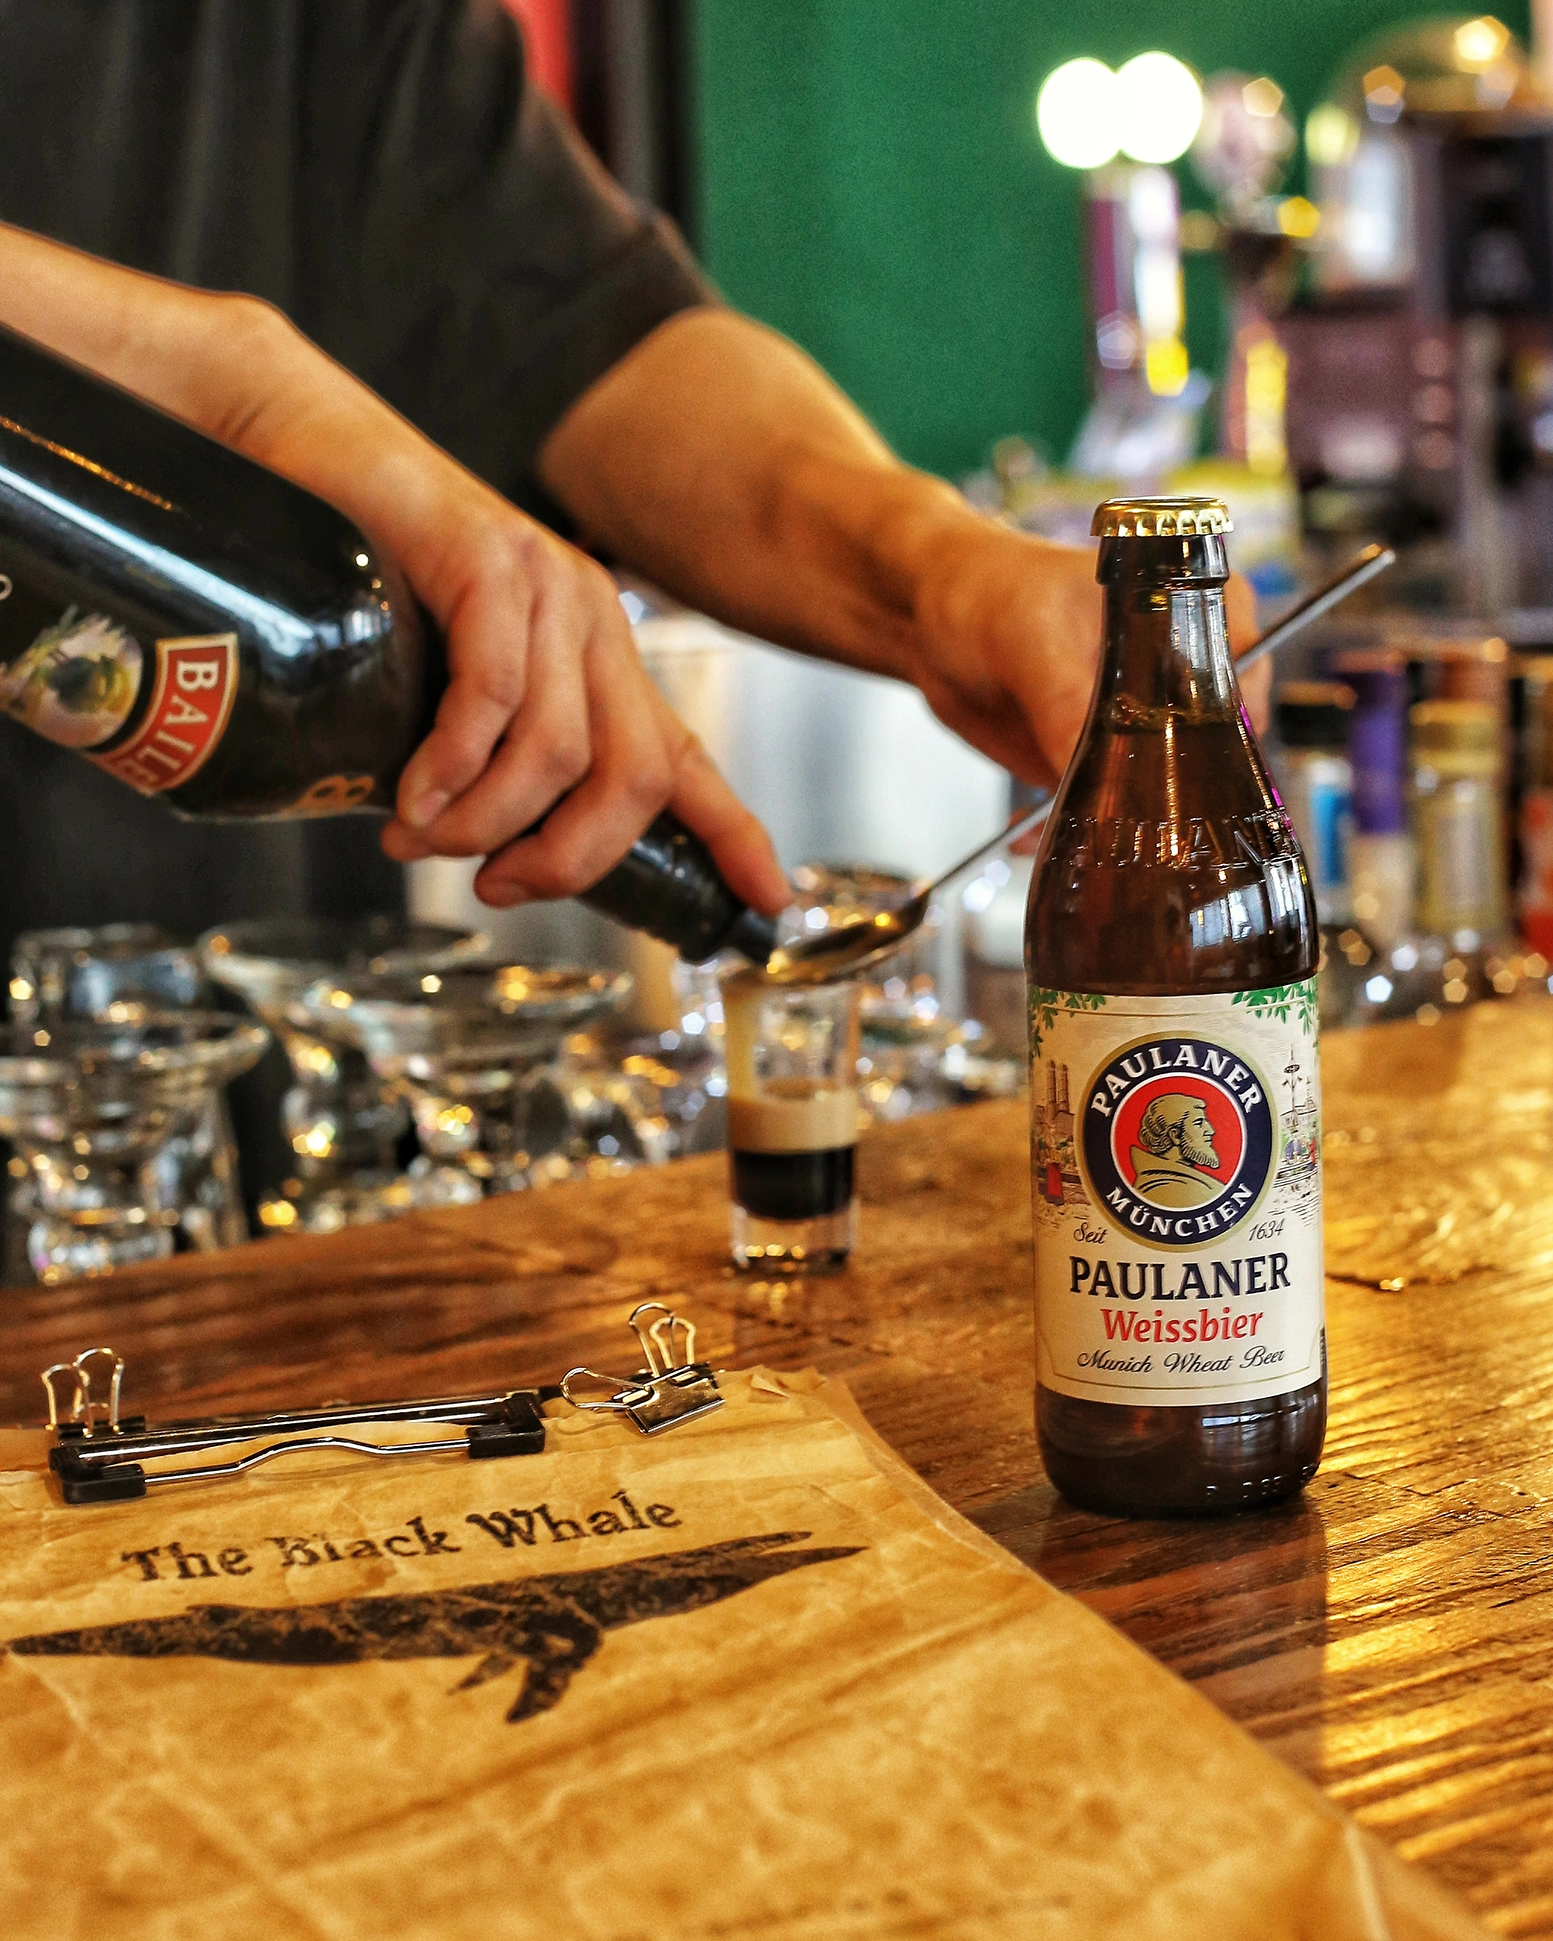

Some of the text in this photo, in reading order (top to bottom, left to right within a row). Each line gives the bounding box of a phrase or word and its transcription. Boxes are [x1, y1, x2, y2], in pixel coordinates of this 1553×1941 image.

[1090, 1044, 1263, 1118] PAULANER
[1073, 1218, 1286, 1245] Seit 1634
[1105, 1181, 1255, 1239] MÜNCHEN
[1069, 1252, 1292, 1301] PAULANER
[1100, 1308, 1264, 1343] Weissbier
[1077, 1344, 1286, 1374] Munich Wheat Beer
[121, 1490, 684, 1582] The Black Whale
